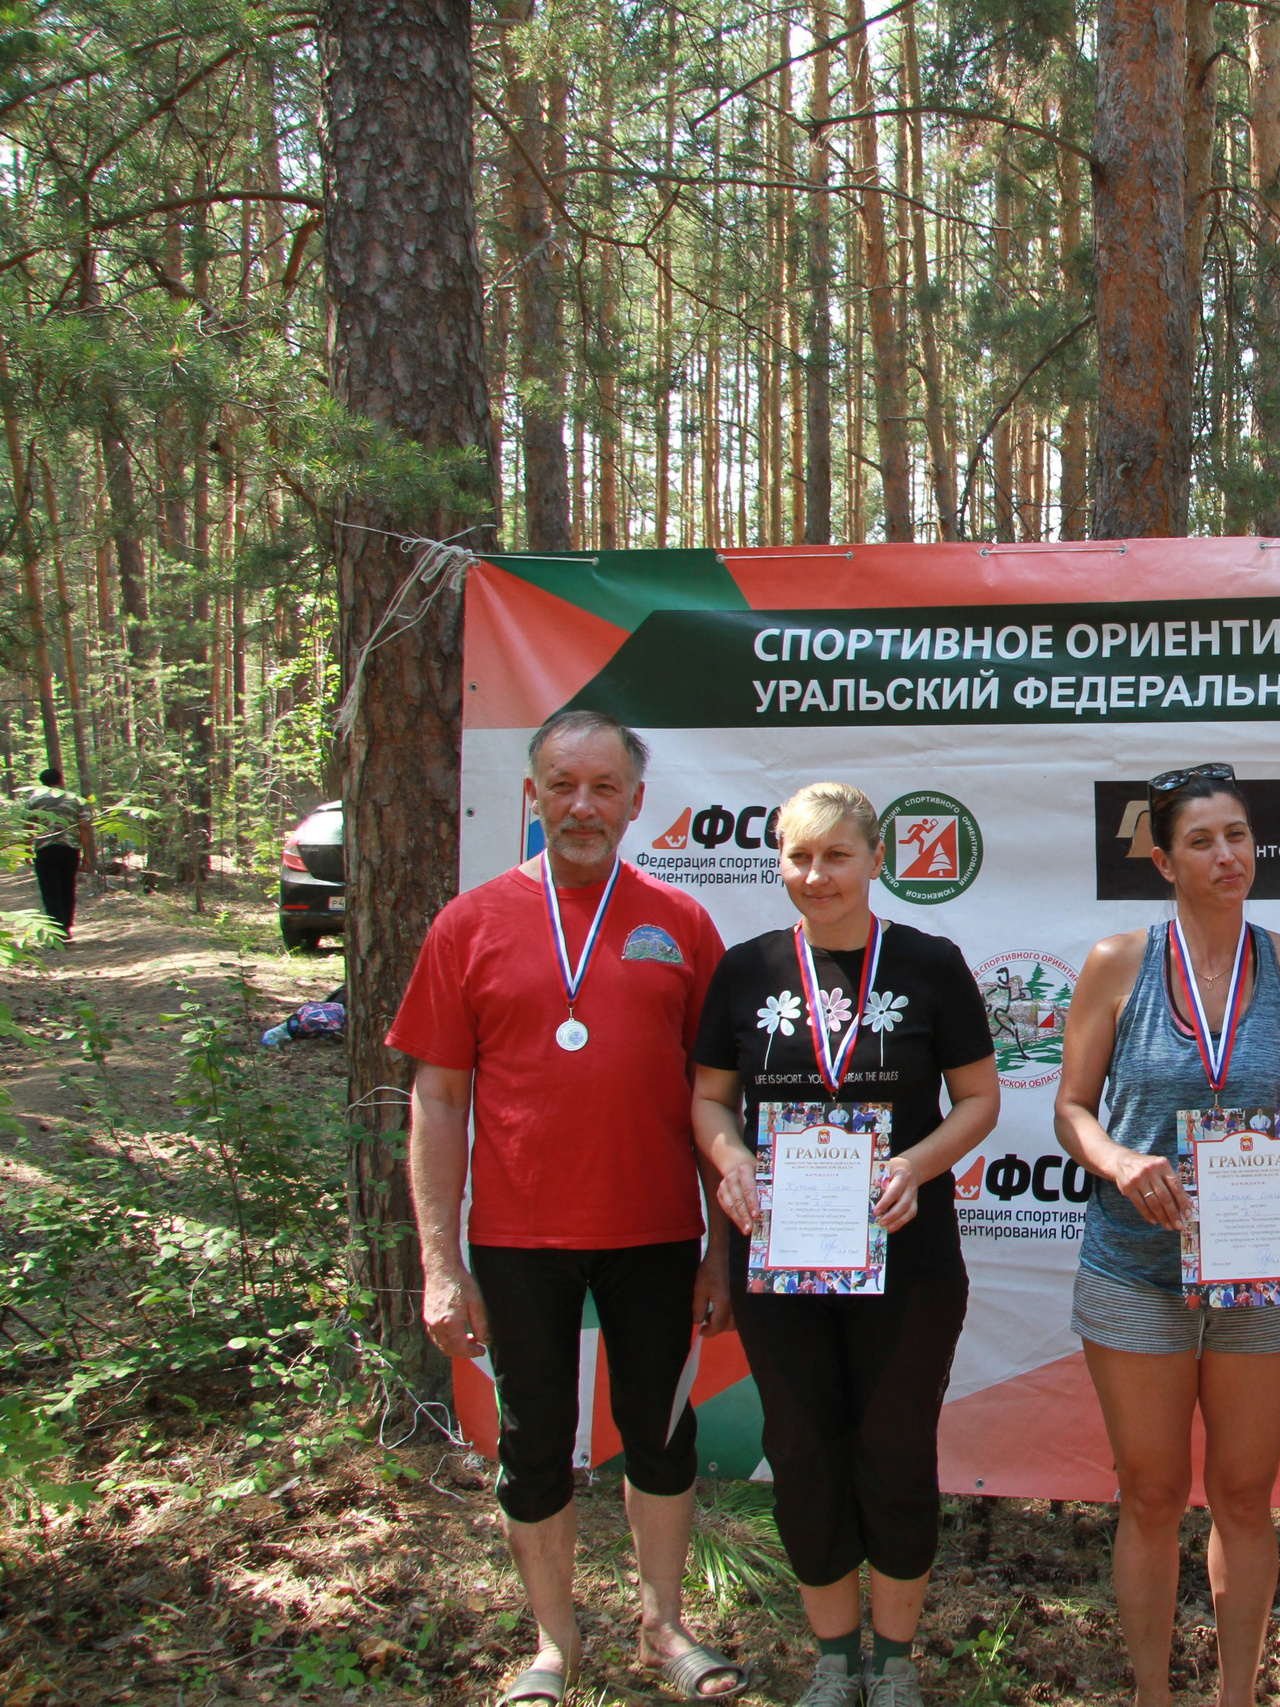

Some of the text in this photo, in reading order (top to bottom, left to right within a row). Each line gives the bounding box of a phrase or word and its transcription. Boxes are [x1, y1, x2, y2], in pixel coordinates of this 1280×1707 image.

[753, 624, 1053, 662] СПОРТИВНОЕ
[752, 669, 999, 712] УРАЛЬСКИЙ
[879, 806, 901, 841] ДЕРАЦИЯ
[905, 796, 978, 886] СПОРТИВНОГО ОРИЕНТИРОВАНИЯ
[637, 852, 716, 870] Федерация
[647, 871, 757, 887] риентирования
[881, 860, 956, 900] ТЮМЕНСКОЙ ОБЛАС
[980, 952, 1040, 973] СПОРТИВНОГО
[755, 1075, 767, 1084] LIFE
[768, 1074, 775, 1084] IS
[865, 1071, 876, 1081] THE
[879, 1071, 899, 1081] RULES
[1029, 1068, 1063, 1087] ОБЛАСТ
[785, 1147, 861, 1159] ГРАМОТА
[985, 1153, 1092, 1203] ФСО
[956, 1208, 1012, 1223] ерация
[960, 1224, 1083, 1240] ентирования Юг
